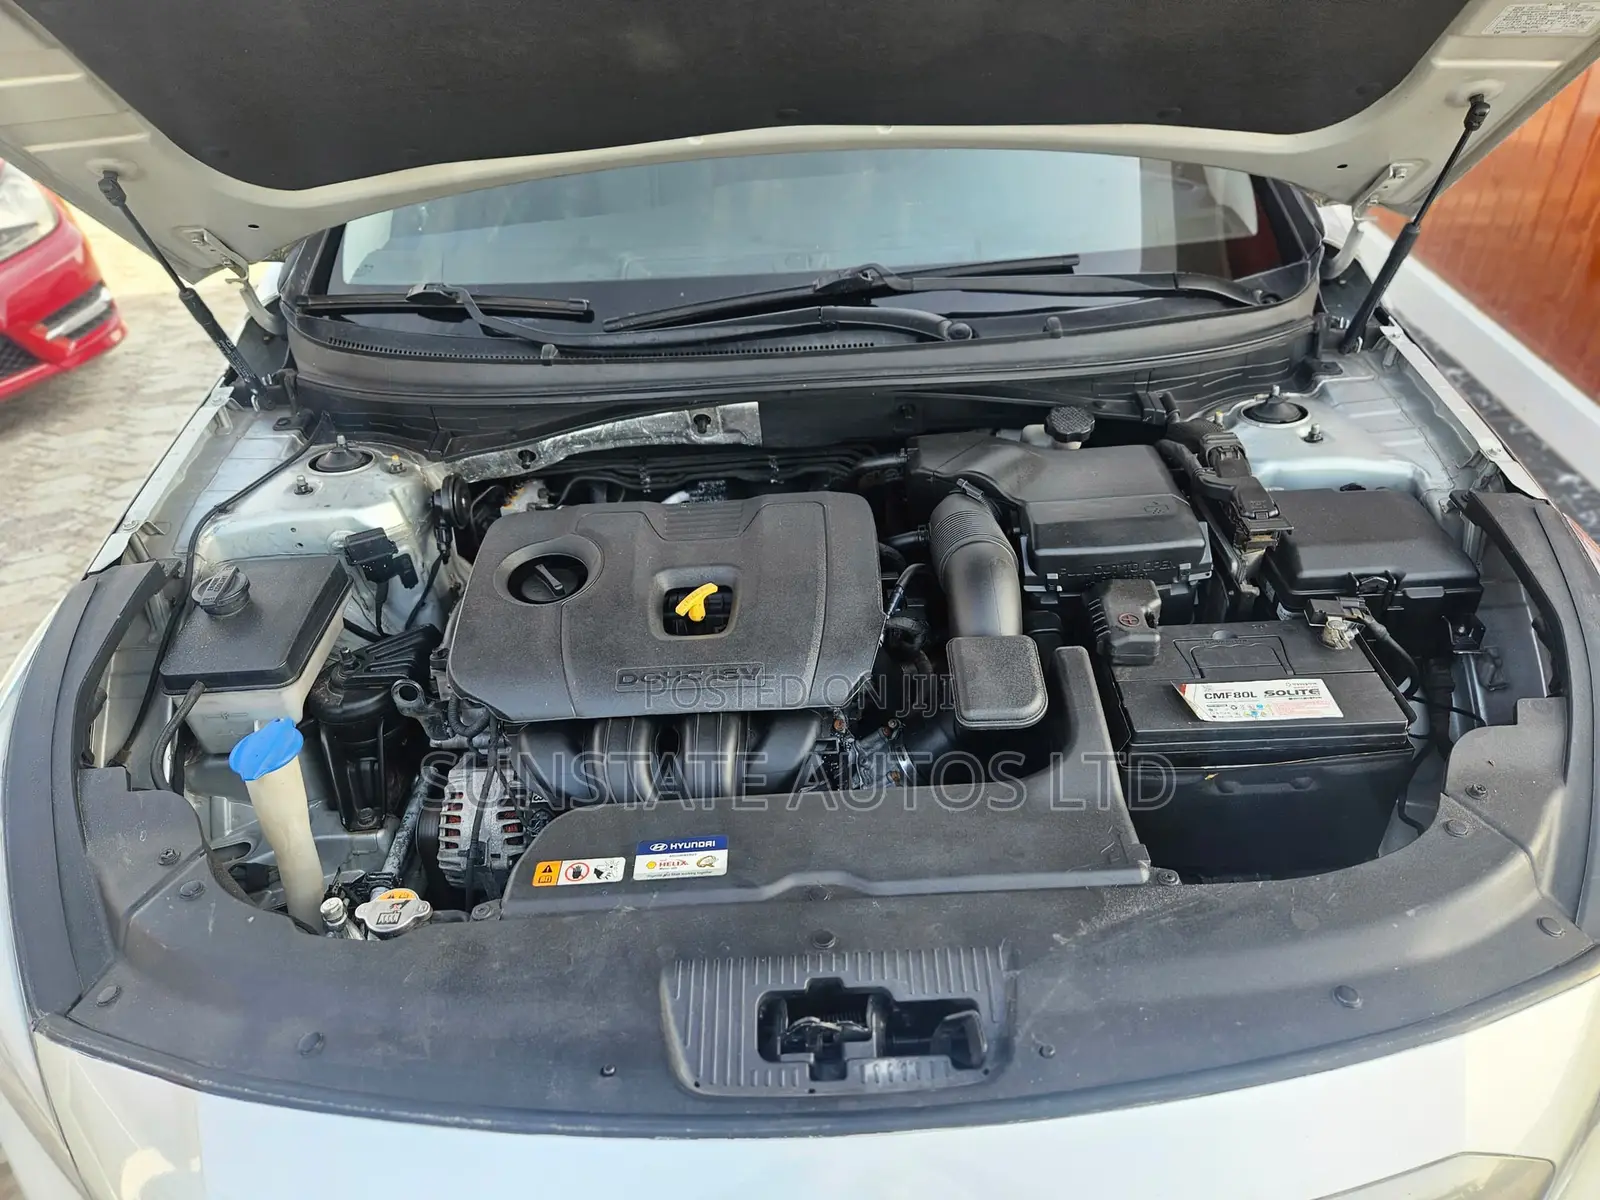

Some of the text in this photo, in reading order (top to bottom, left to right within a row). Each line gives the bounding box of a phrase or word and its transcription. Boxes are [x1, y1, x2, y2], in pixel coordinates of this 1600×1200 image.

[1204, 688, 1320, 700] CMF80L SOLITE
[670, 840, 716, 850] HYUNDAI
